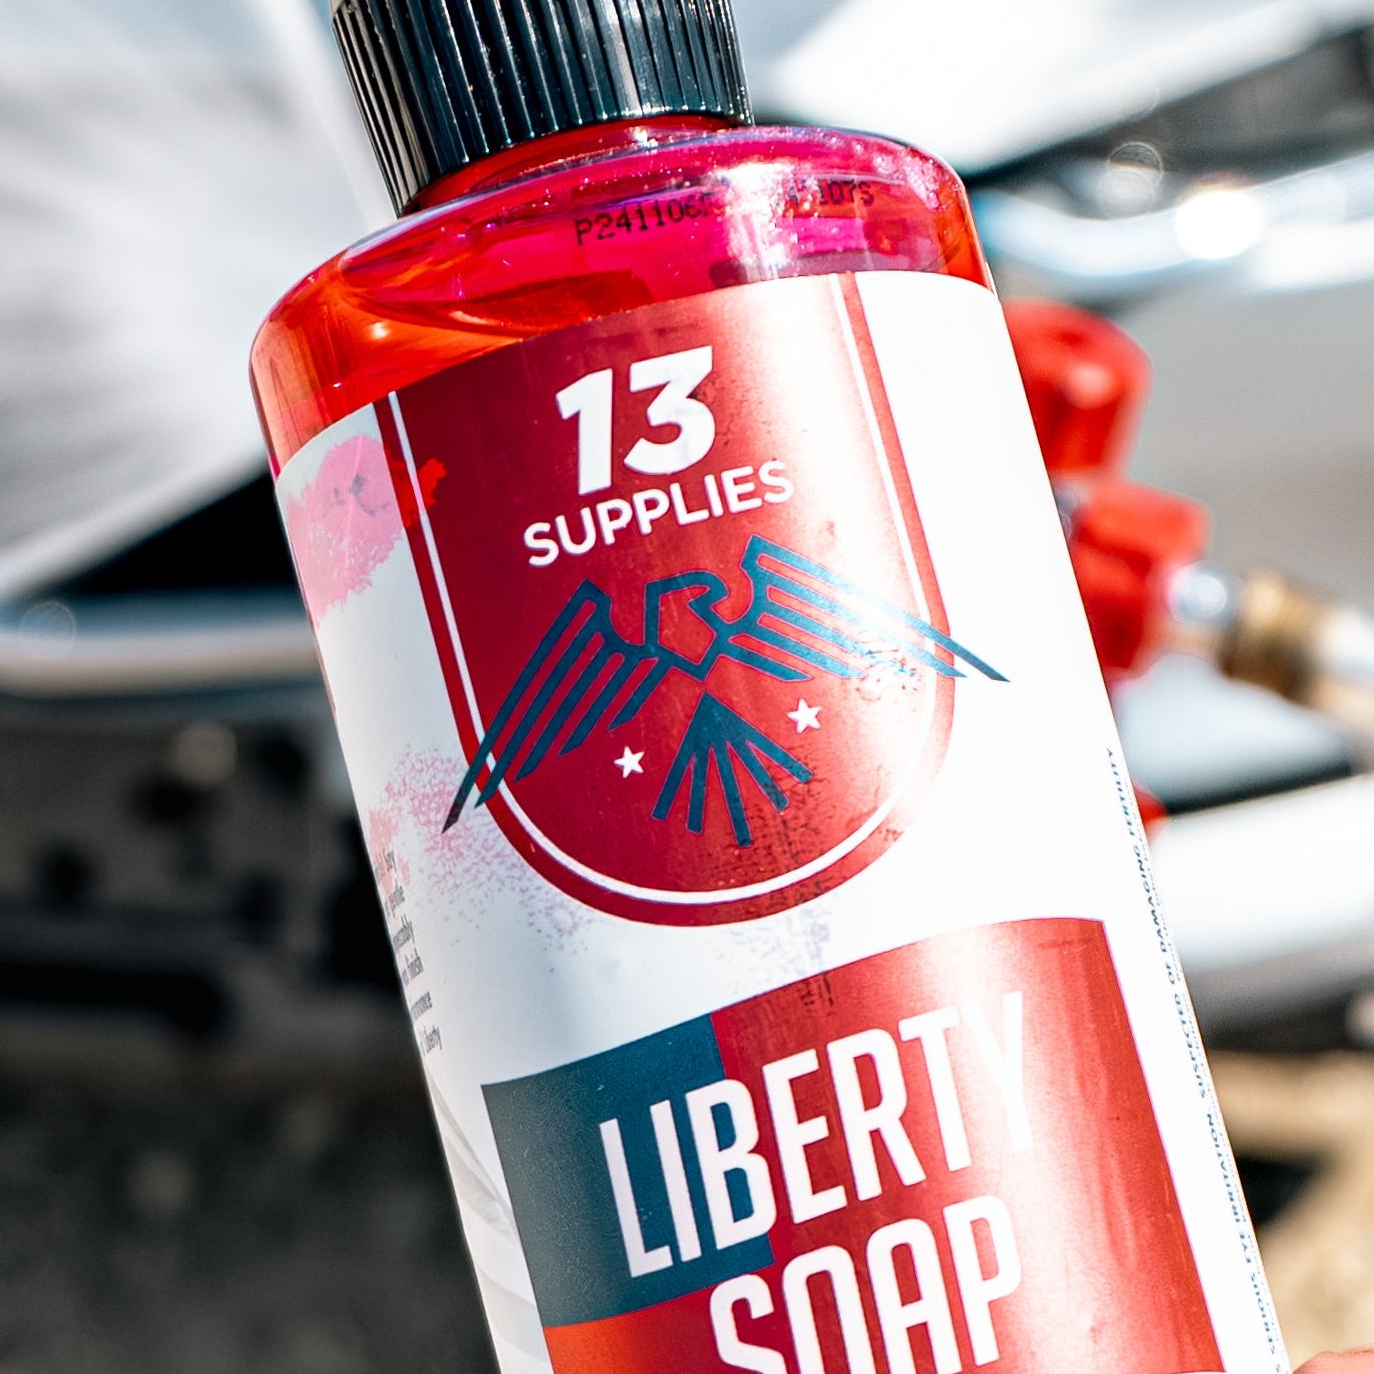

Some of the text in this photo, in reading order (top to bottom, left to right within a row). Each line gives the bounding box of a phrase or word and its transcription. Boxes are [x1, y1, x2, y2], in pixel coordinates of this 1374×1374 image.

[556, 345, 716, 496] 13
[524, 459, 793, 568] SUPPLIES
[599, 991, 1035, 1278] LIBERTY
